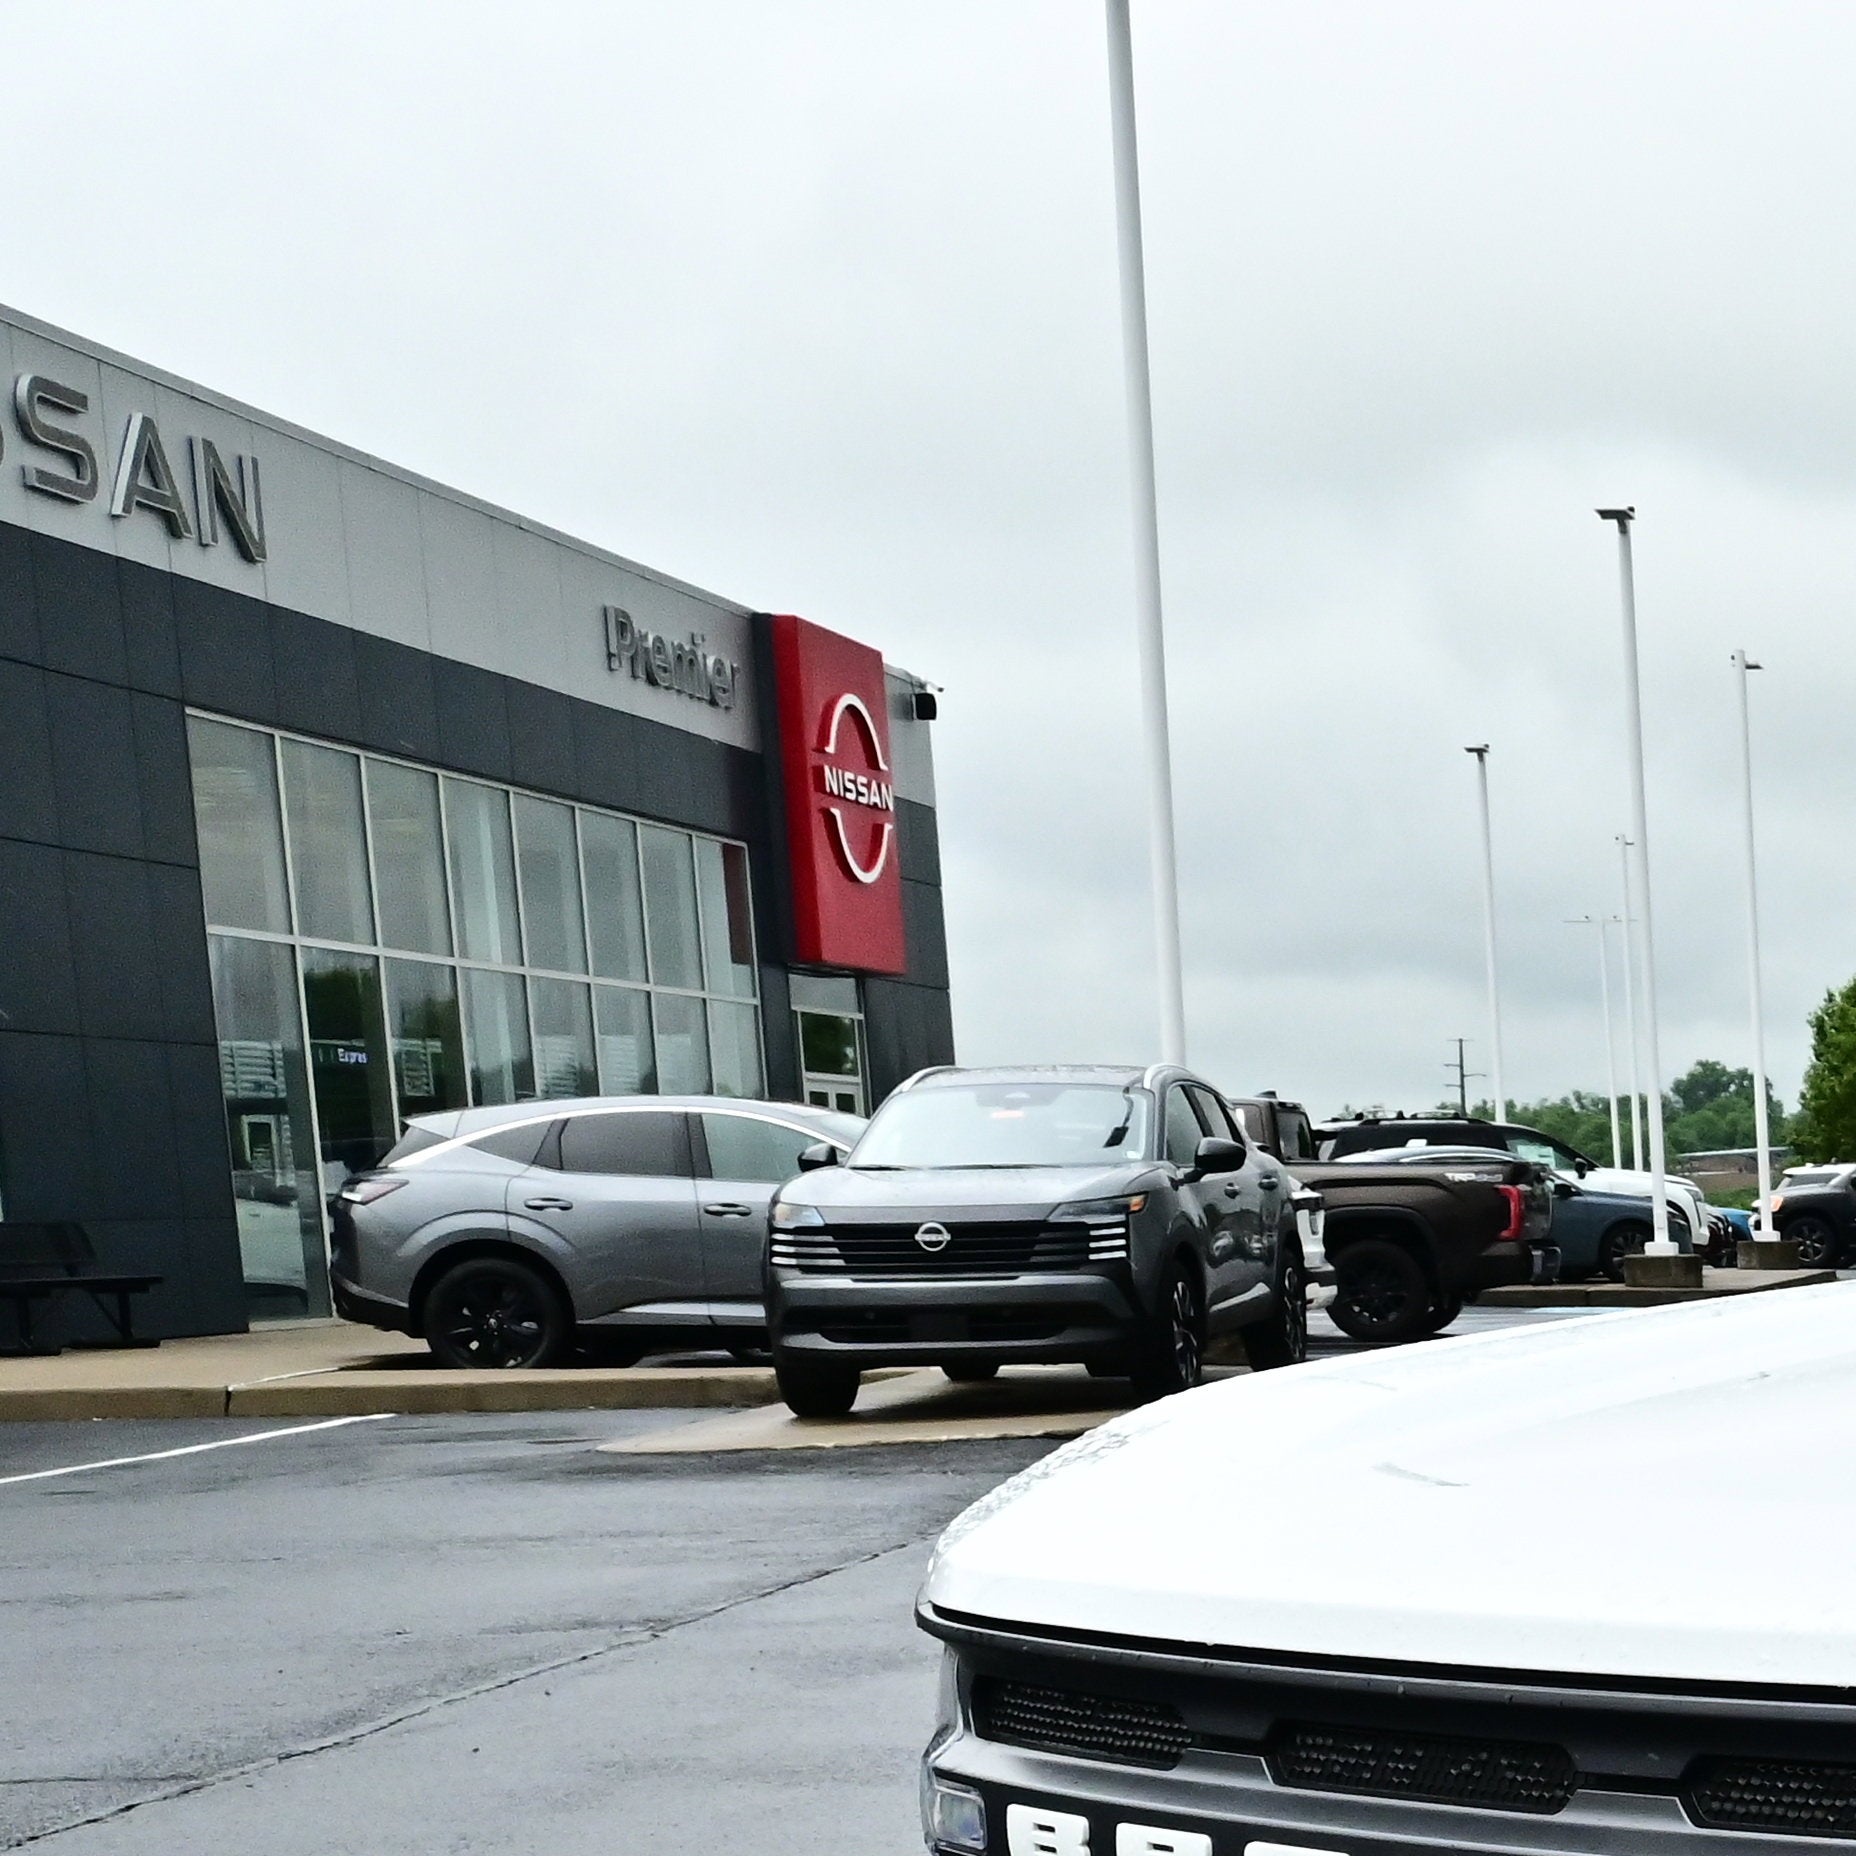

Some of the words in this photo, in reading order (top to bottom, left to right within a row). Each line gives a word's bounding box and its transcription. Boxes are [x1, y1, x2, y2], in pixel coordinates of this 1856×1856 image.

[0, 374, 267, 565] SAN
[603, 604, 740, 711] Premier
[823, 765, 894, 812] NISSAN
